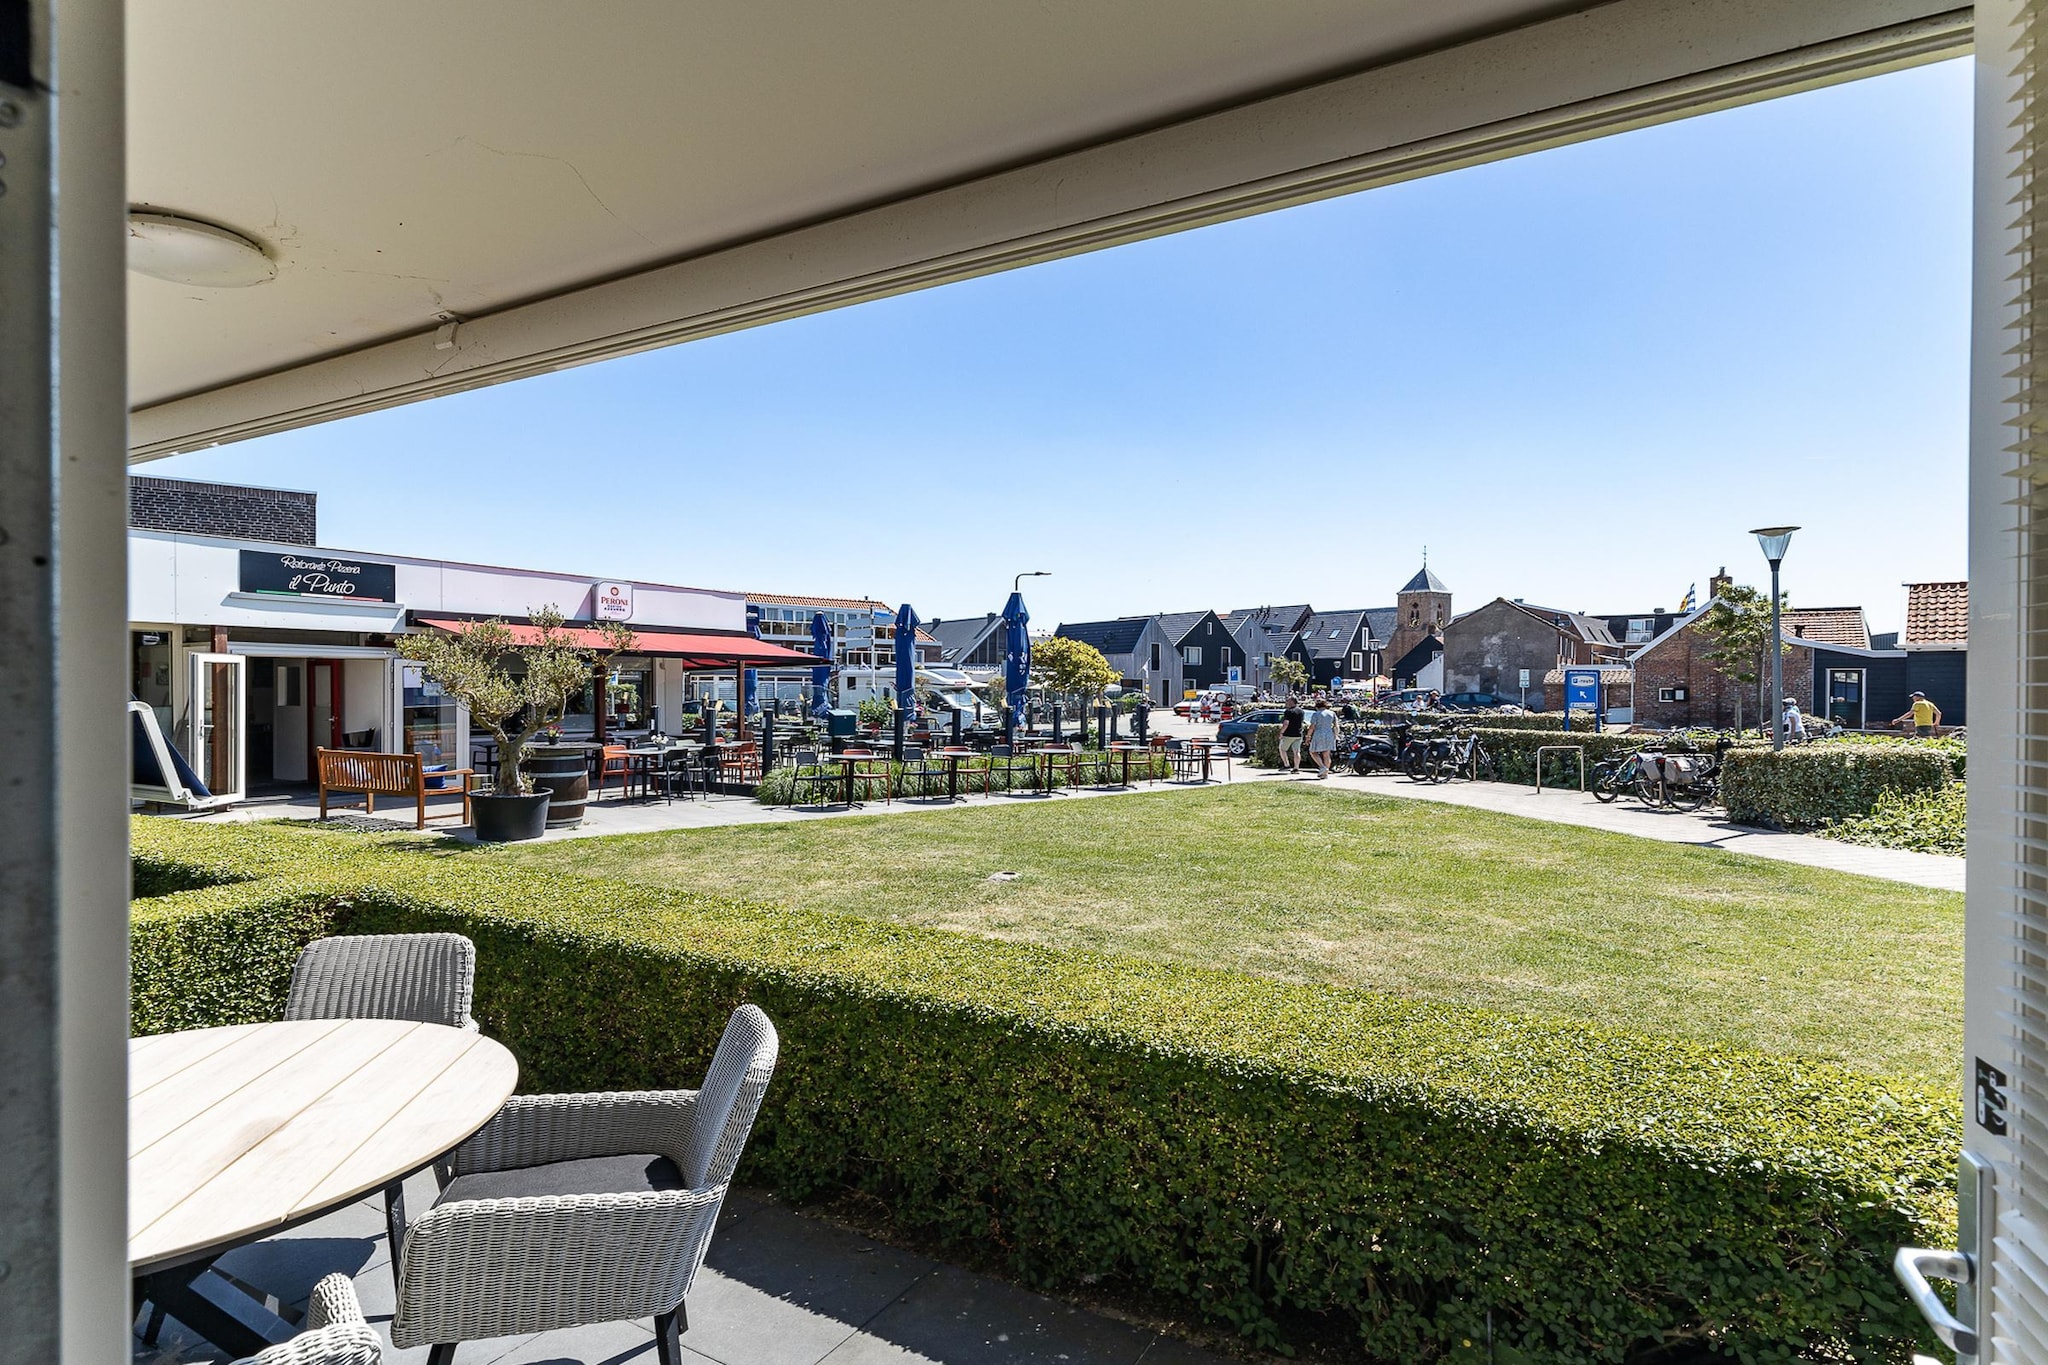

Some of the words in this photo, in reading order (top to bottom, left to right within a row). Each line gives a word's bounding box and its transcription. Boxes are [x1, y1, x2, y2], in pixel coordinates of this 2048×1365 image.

[281, 555, 326, 571] Ristorante
[327, 560, 361, 575] Pizzeria
[288, 574, 302, 590] il
[303, 572, 355, 595] Punto
[601, 596, 628, 606] PERONI
